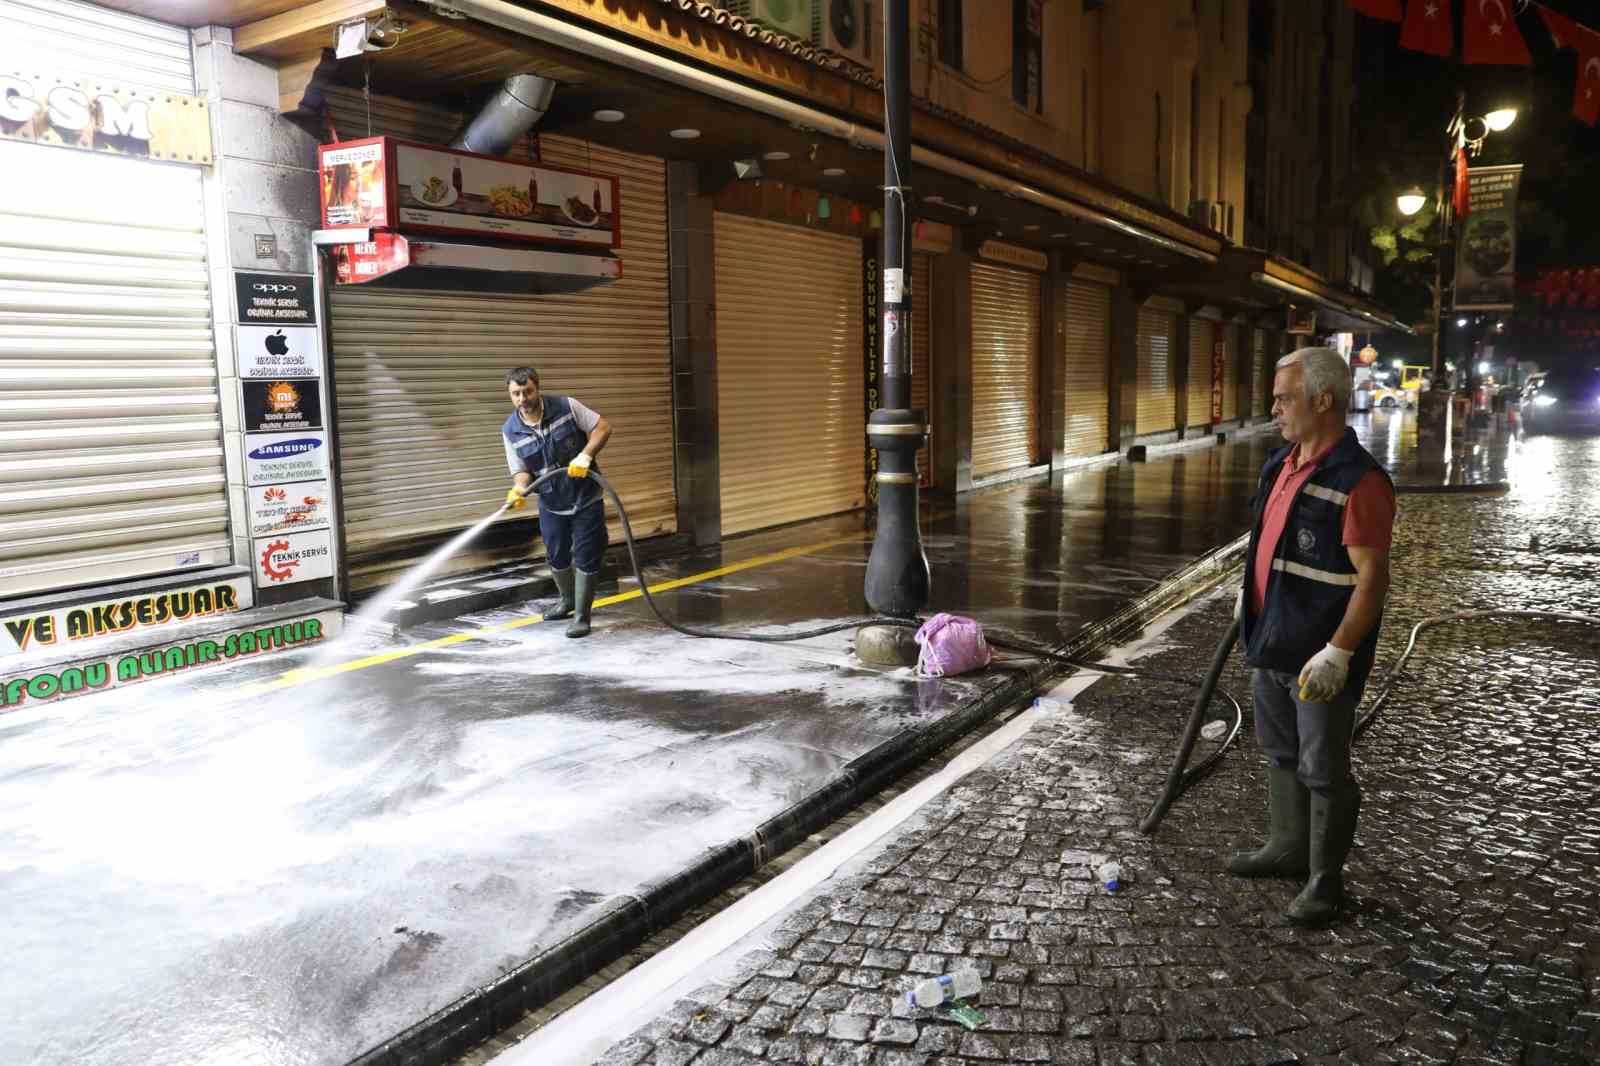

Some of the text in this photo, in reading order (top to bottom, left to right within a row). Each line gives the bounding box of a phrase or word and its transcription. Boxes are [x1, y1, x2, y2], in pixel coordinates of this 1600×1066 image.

[0, 75, 153, 140] GSM
[258, 443, 314, 455] SAMSUNG
[272, 544, 328, 562] TEKNİK SERVİS
[5, 584, 237, 650] VE AKSESUAR
[0, 660, 111, 705] FONU
